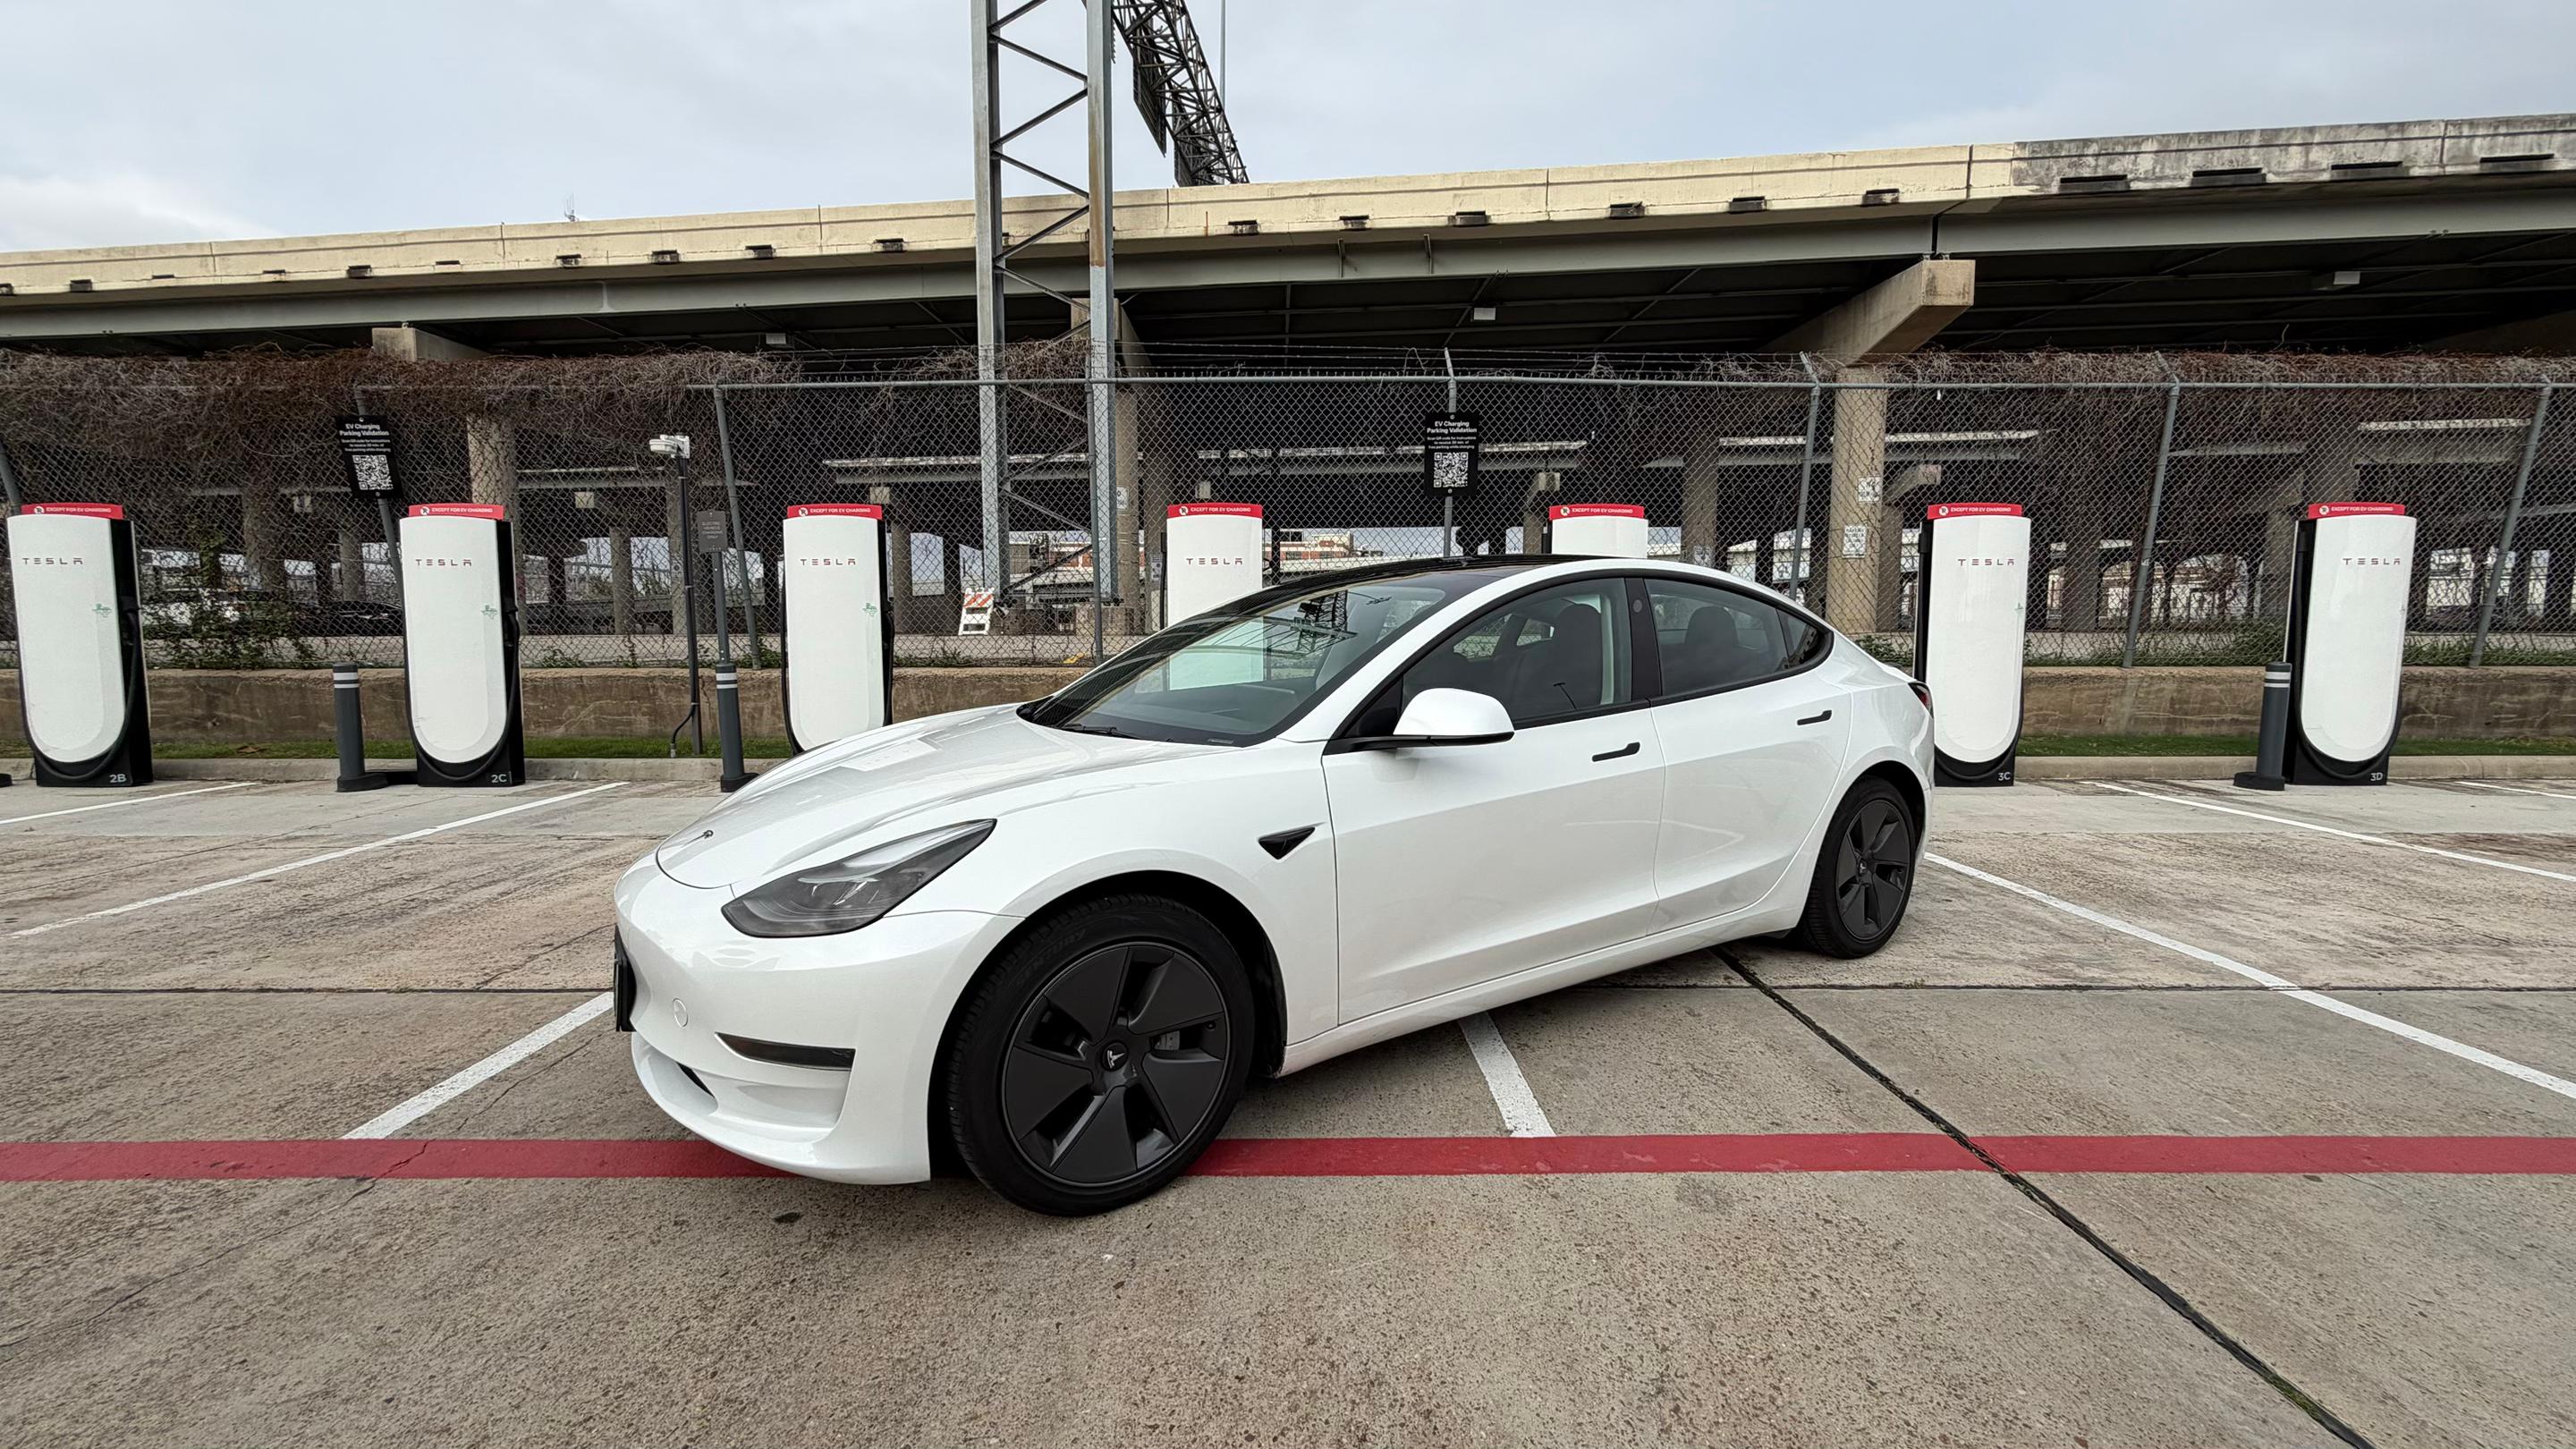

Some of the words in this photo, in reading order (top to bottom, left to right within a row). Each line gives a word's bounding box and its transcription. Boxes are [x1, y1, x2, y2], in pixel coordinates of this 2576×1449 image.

[109, 774, 126, 783] 2B
[491, 774, 507, 783] 2C
[1998, 772, 2011, 781] 3C
[2370, 772, 2383, 781] 3D
